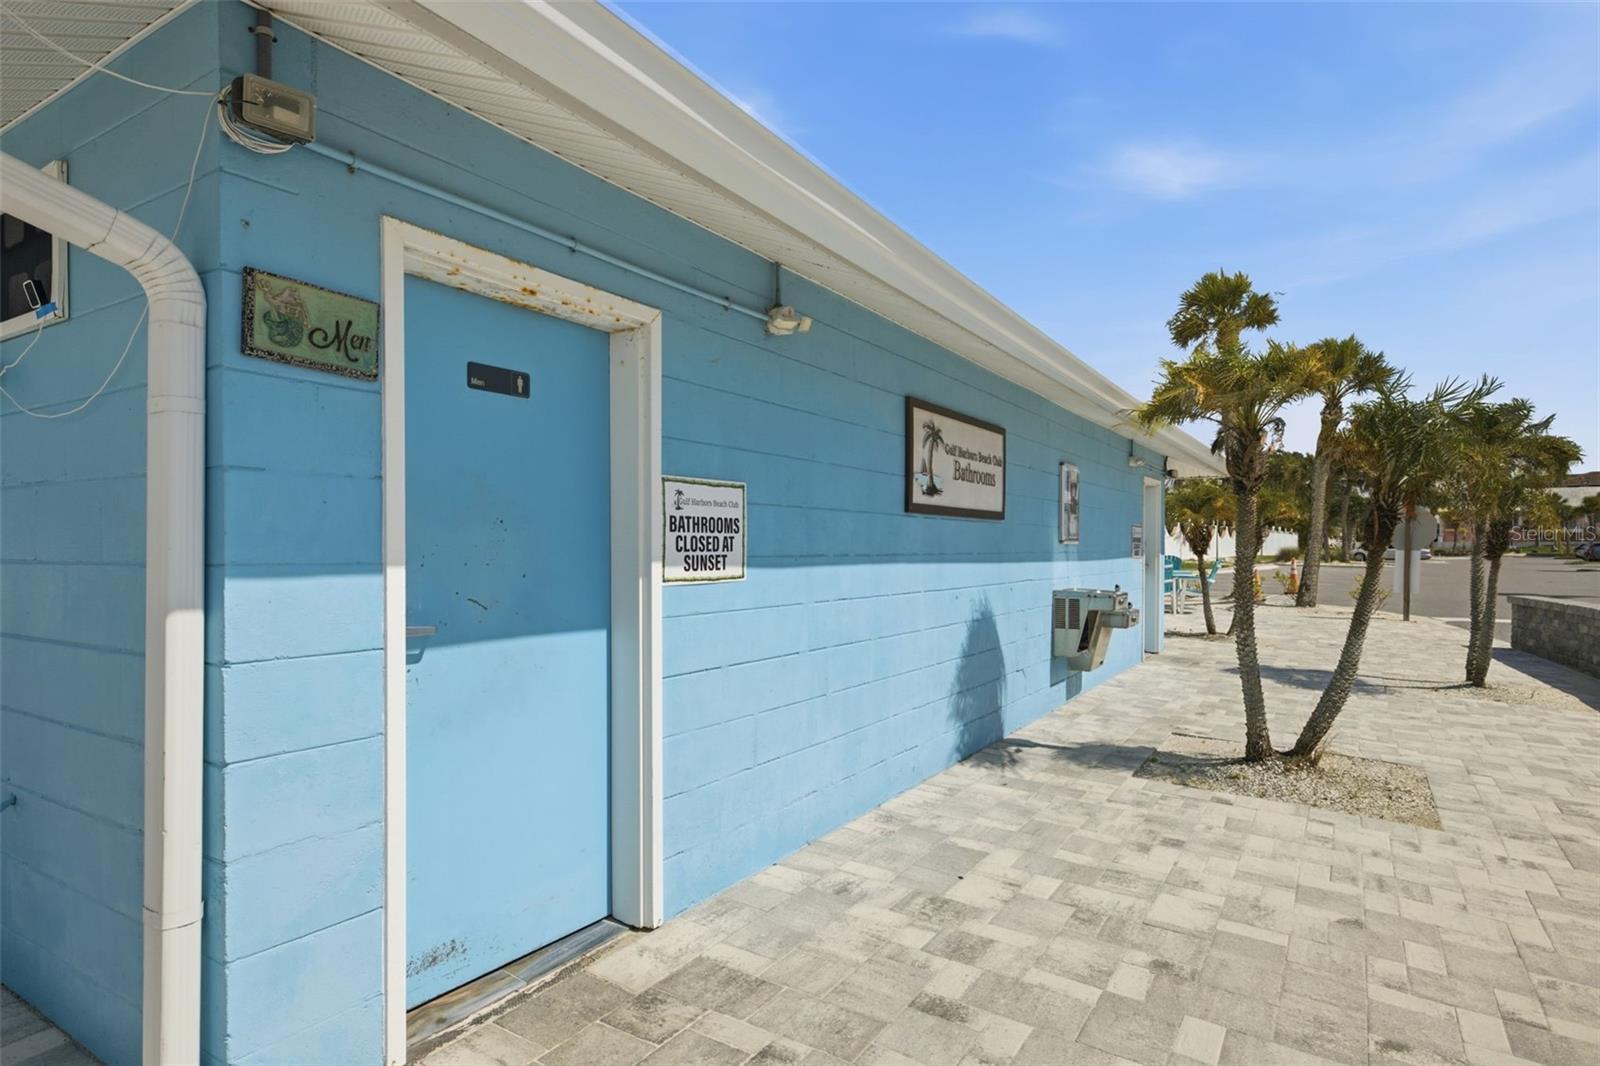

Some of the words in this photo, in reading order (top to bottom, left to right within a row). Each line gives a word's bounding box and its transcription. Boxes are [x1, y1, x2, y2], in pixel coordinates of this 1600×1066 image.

[308, 320, 371, 362] Men
[953, 459, 996, 487] Bathrooms
[691, 498, 712, 507] Harbors
[713, 500, 727, 508] Beach
[728, 500, 739, 508] Club
[669, 515, 740, 534] BATHROOMS
[675, 535, 720, 553] CLOSED
[722, 536, 735, 552] AT
[683, 554, 728, 572] SUNSET
